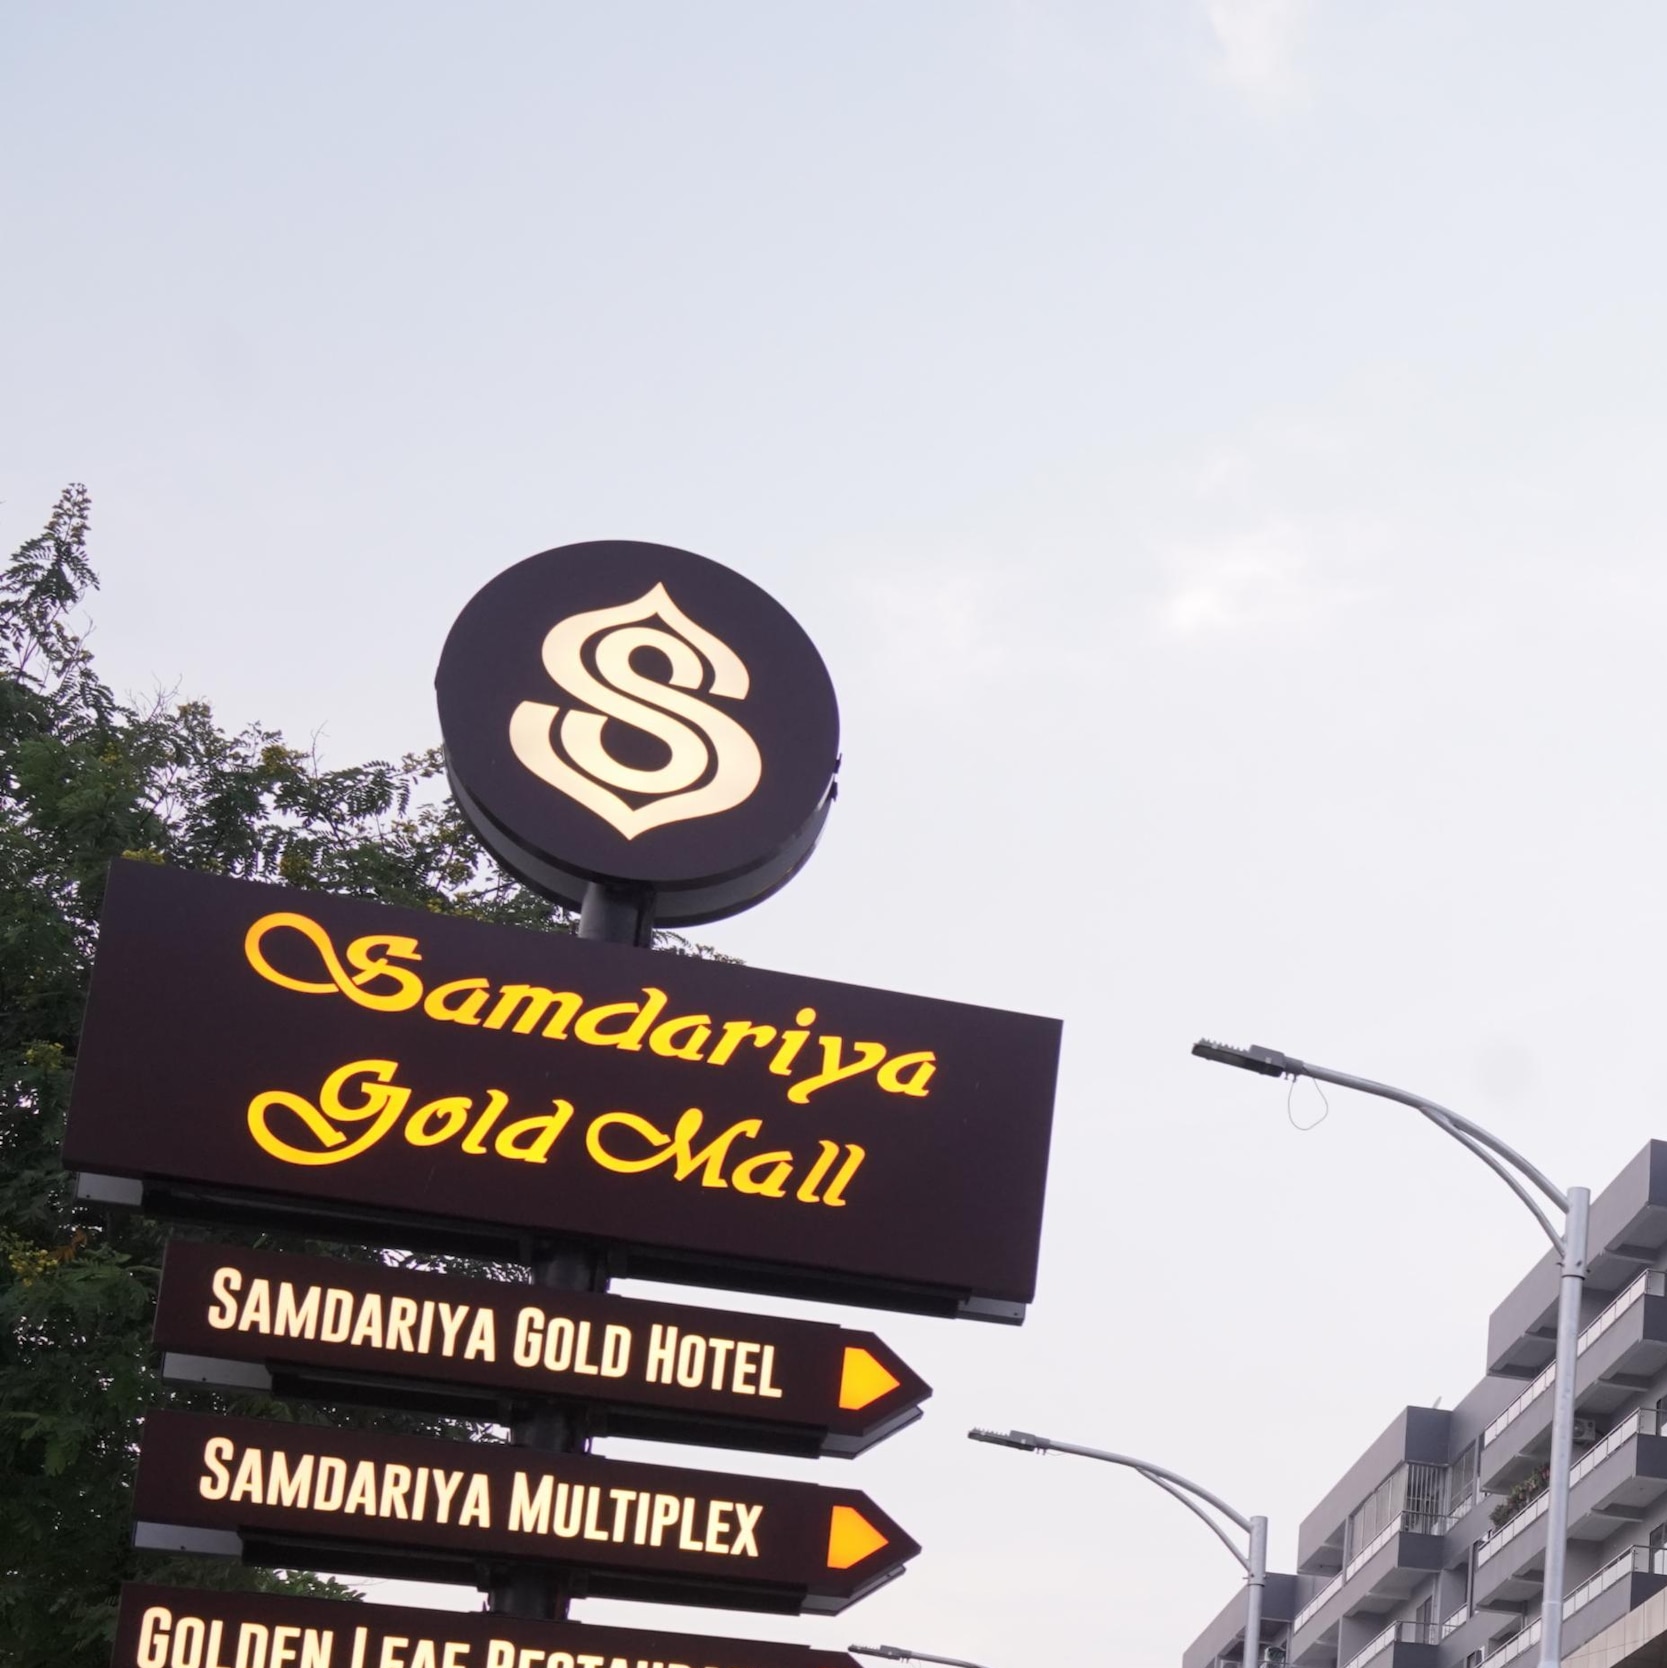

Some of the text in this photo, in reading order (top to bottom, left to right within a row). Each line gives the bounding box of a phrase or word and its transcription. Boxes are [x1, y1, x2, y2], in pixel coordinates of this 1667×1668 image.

[244, 910, 938, 1105] Samdariya
[246, 1058, 866, 1207] Gold Mall
[208, 1267, 783, 1398] SAMDARIYA GOLD HOTEL
[199, 1437, 764, 1557] SAMDARIYA MULTIPLEX
